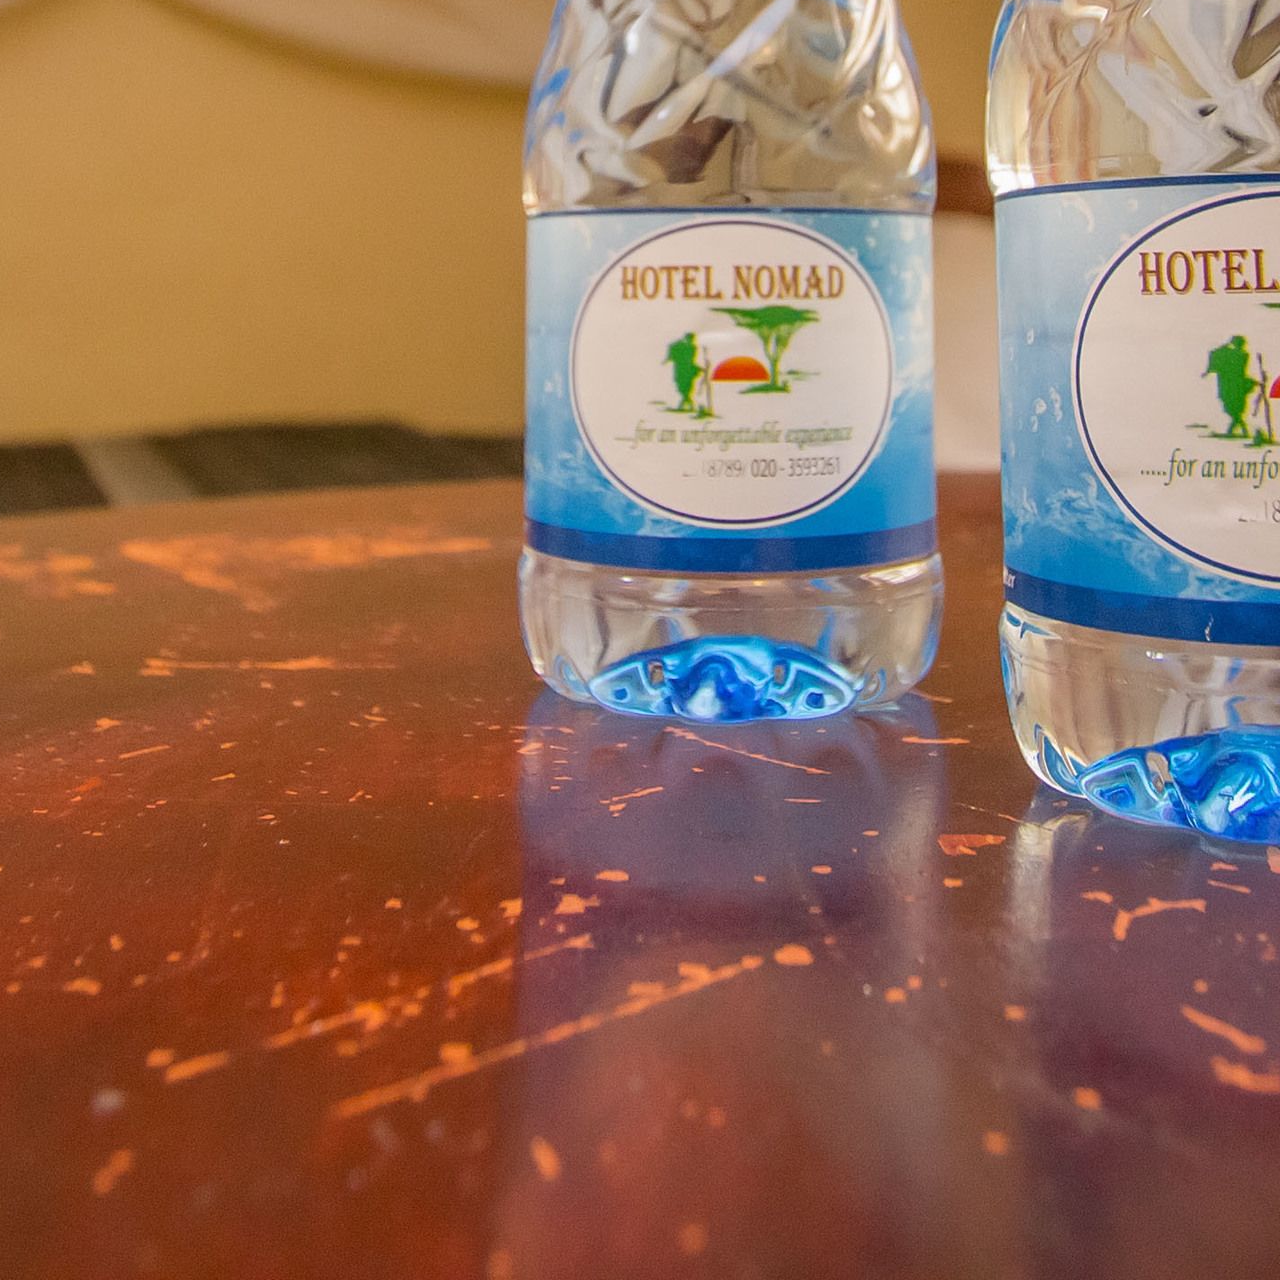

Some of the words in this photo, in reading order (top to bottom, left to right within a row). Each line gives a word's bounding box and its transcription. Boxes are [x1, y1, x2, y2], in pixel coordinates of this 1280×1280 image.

[621, 265, 723, 301] HOTEL
[732, 265, 845, 300] NOMAD
[1138, 248, 1280, 295] HOTEL
[1201, 459, 1226, 479] an
